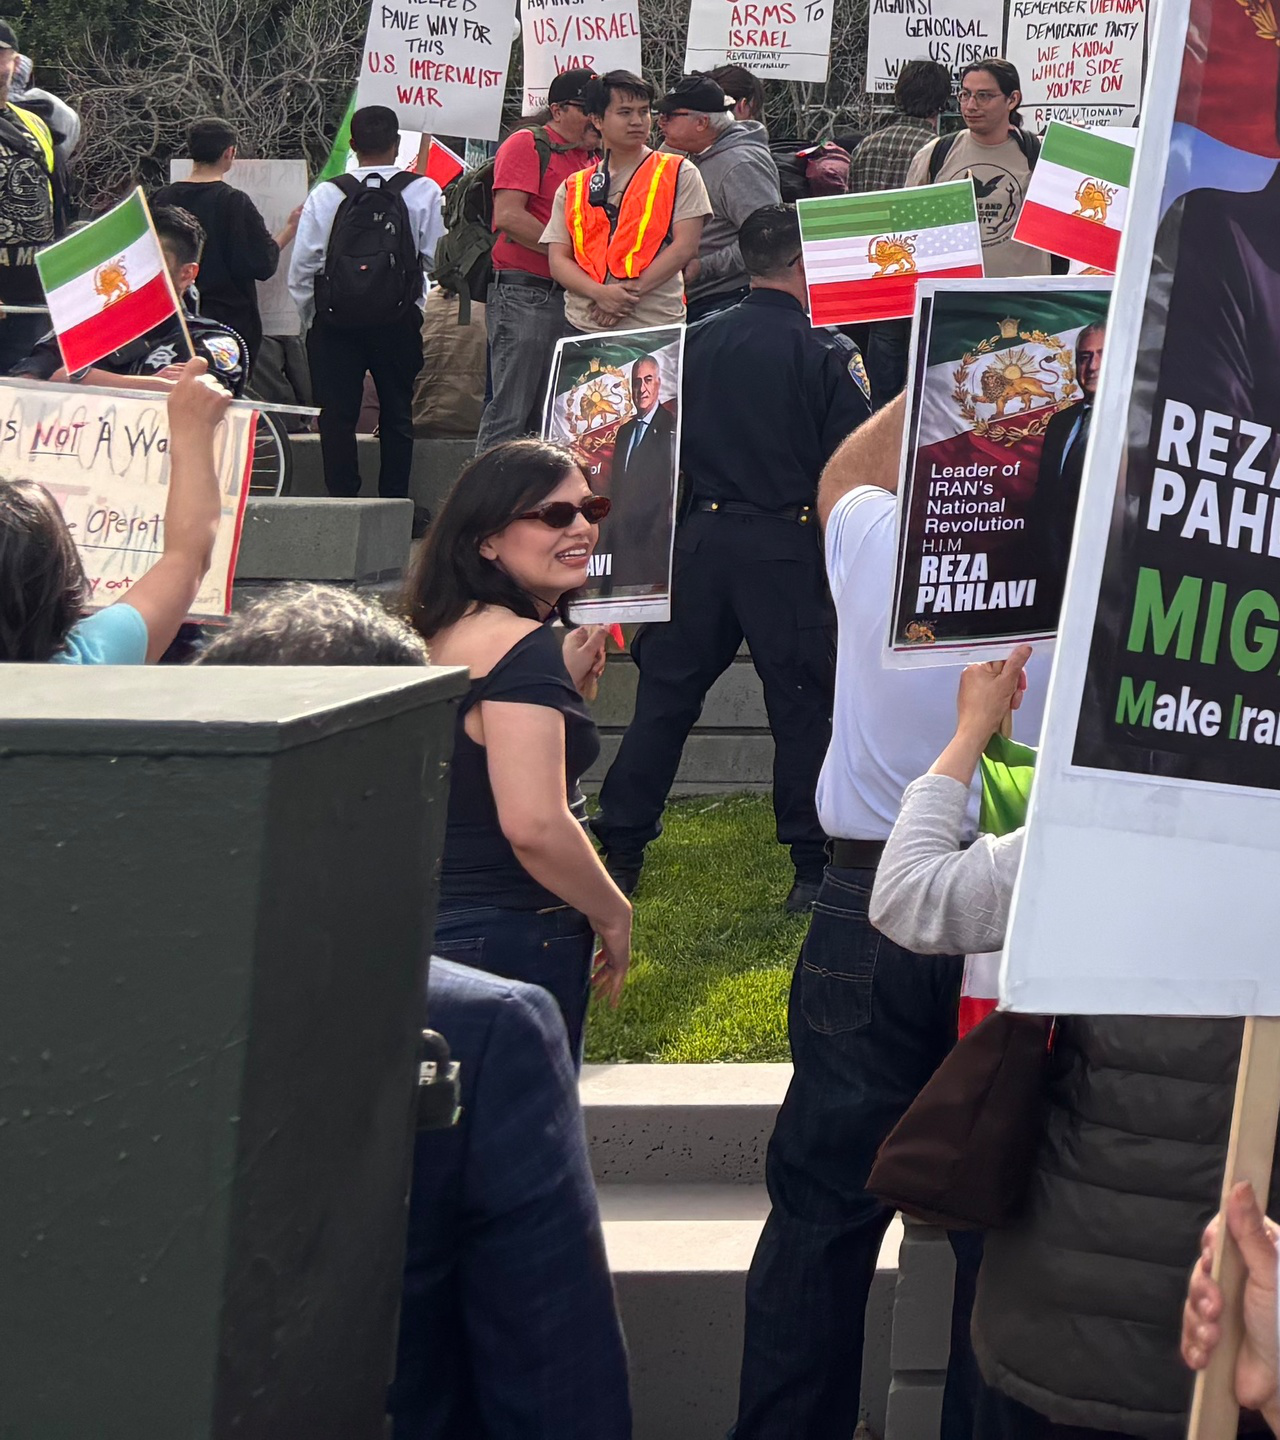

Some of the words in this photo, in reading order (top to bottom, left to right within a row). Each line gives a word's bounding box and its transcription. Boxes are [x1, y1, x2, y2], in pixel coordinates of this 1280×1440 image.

[731, 3, 796, 26] ARMS
[1014, 0, 1086, 18] REMEMBER
[382, 5, 419, 30] PAVE
[427, 15, 458, 36] WAY
[464, 19, 491, 45] FOR
[906, 17, 987, 37] GENOCIDAL
[1027, 22, 1098, 40] DEMOCRATIC
[1105, 21, 1138, 40] PARTY
[405, 38, 444, 55] THIS
[729, 30, 791, 48] ISRAEL
[1038, 46, 1060, 62] WE
[1072, 41, 1113, 59] KNOW
[369, 52, 398, 74] U.S.
[410, 58, 502, 88] IMPERIALIST
[1032, 61, 1074, 81] WHICH
[1086, 58, 1123, 76] SIDE
[397, 86, 443, 107] WAR
[1046, 79, 1091, 100] YOU'RE
[1101, 75, 1123, 92] ON
[931, 463, 997, 478] Leader
[1002, 461, 1021, 476] of
[929, 481, 993, 496] IRAN's
[927, 498, 1006, 515] National
[925, 516, 1025, 533] Revolution
[922, 538, 962, 553] H.I.M
[920, 553, 988, 584] REZA
[915, 579, 1037, 614] PAHLAVI
[1114, 676, 1222, 737] Make
